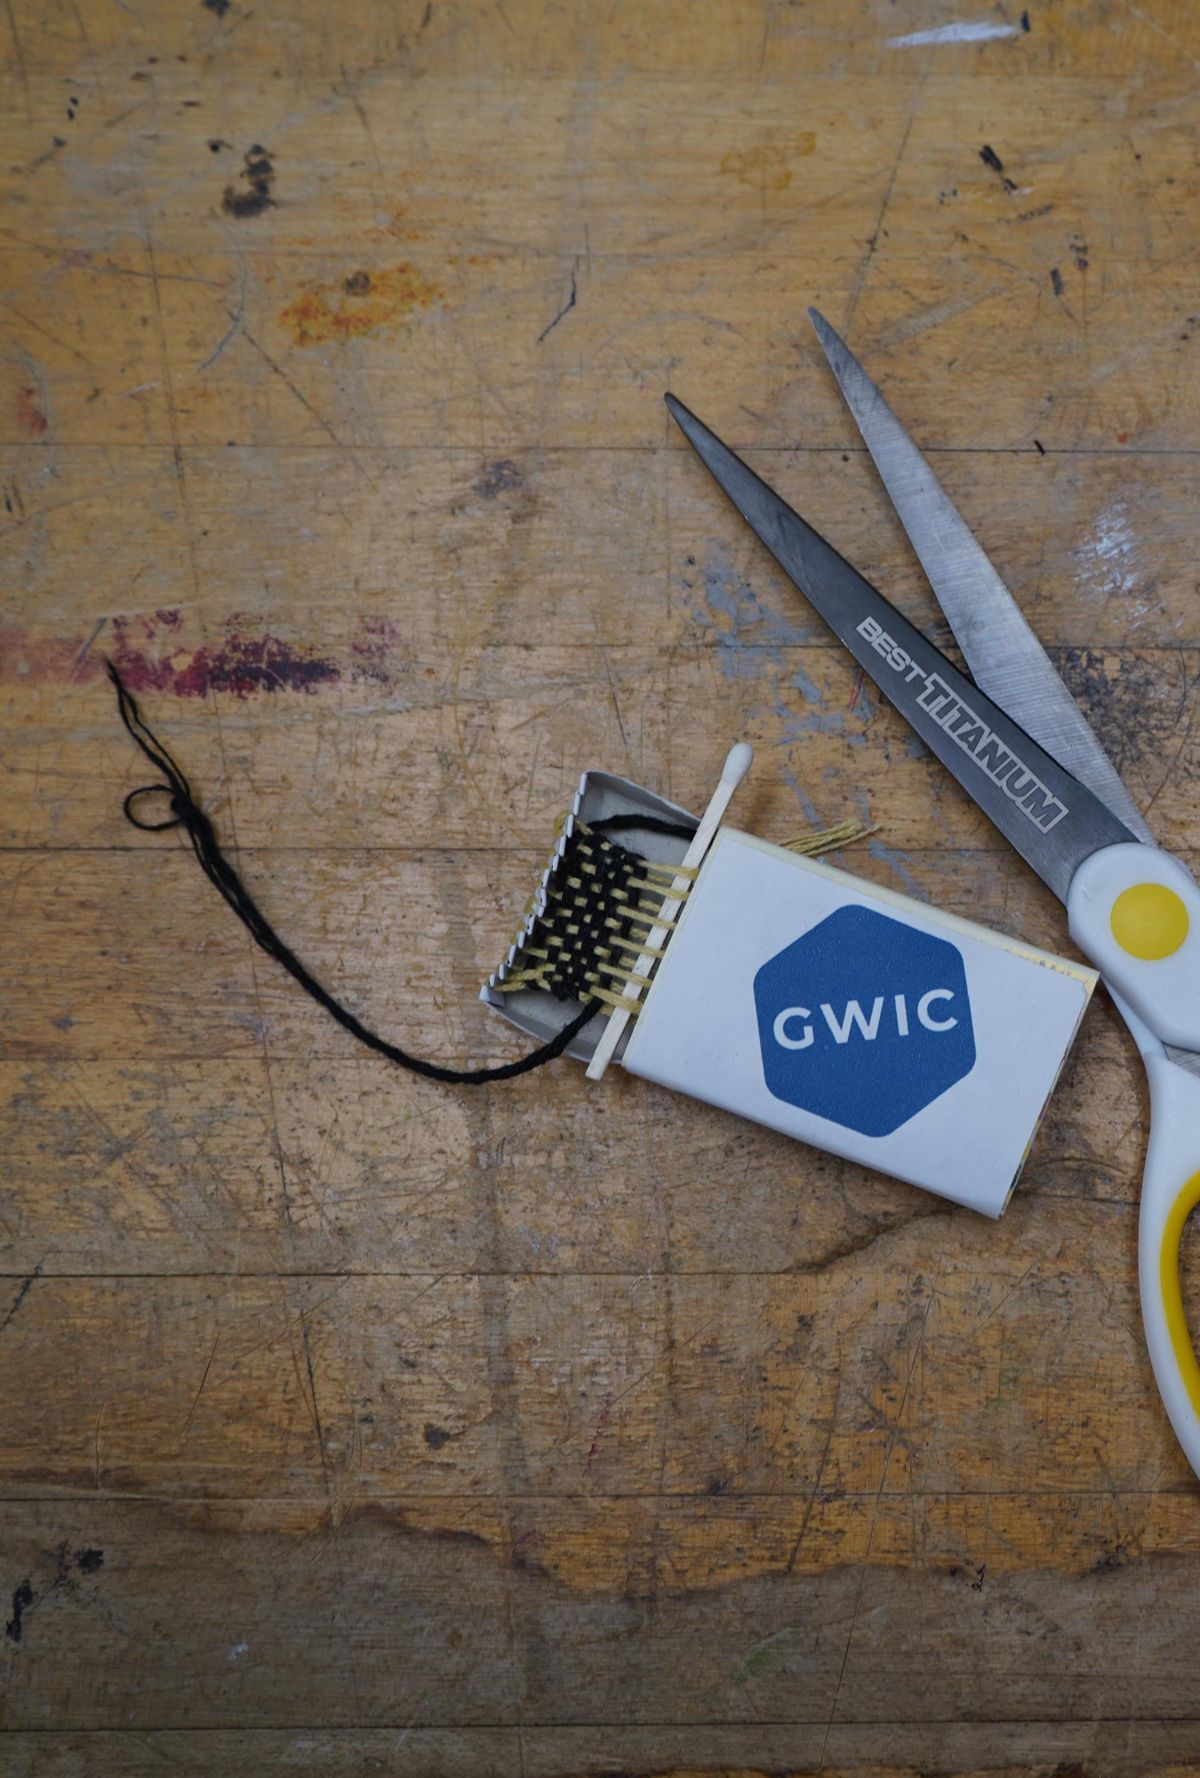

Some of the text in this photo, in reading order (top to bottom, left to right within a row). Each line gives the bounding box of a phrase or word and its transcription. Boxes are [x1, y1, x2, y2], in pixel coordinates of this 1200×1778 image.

[856, 616, 1069, 834] BEST TITANIUM
[773, 988, 958, 1050] GWIC
